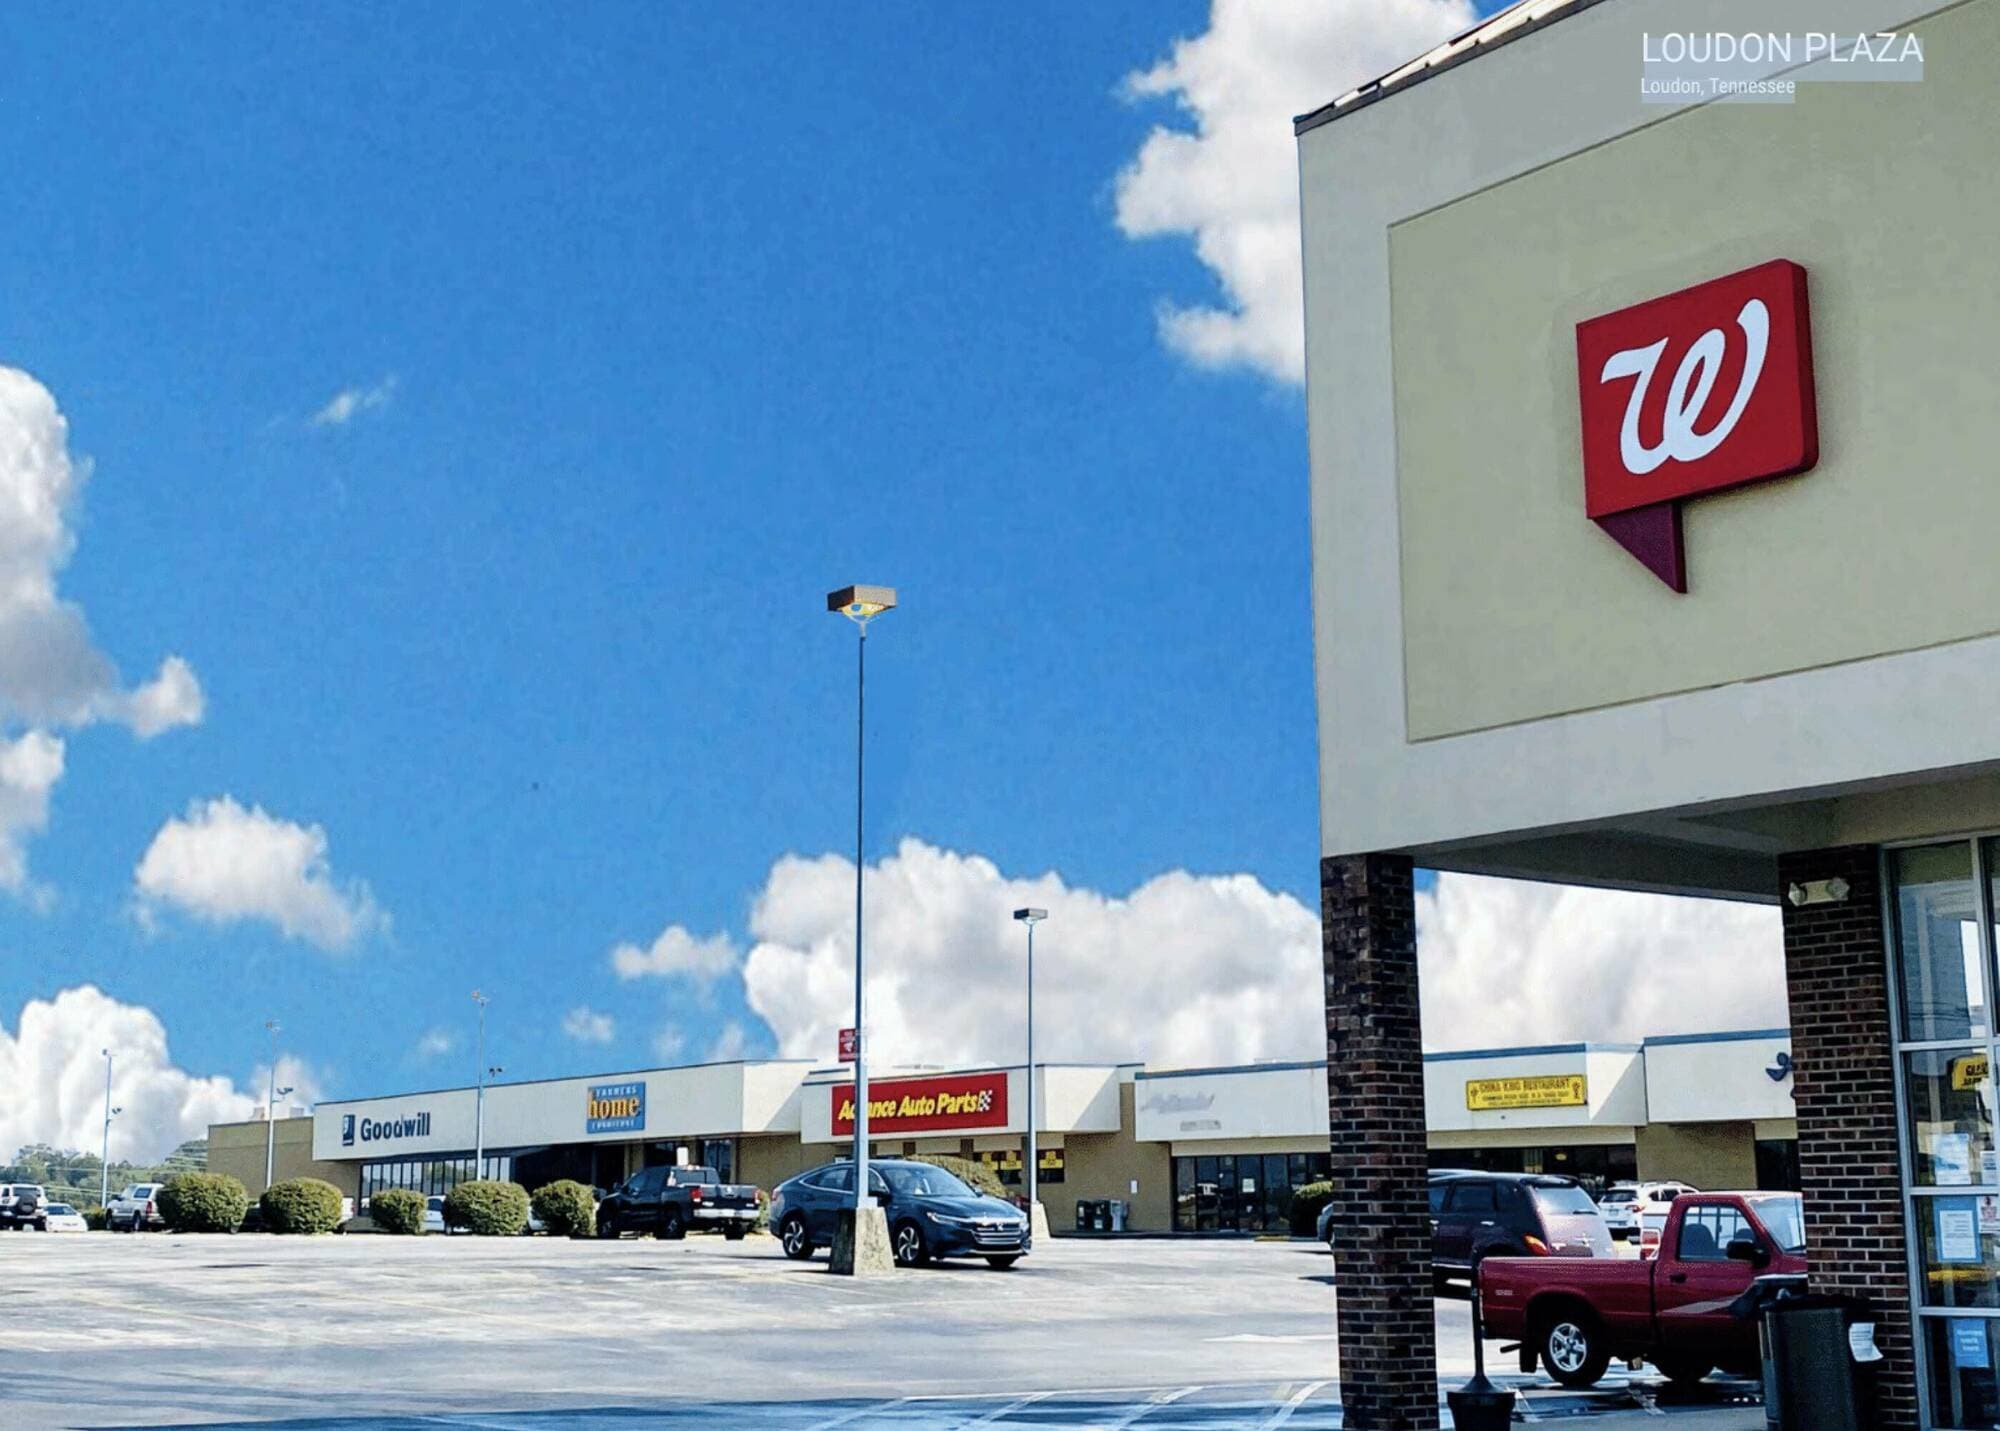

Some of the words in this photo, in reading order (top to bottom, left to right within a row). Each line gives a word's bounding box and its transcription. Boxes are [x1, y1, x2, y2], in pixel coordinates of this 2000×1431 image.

[588, 1091, 640, 1120] home
[897, 1095, 936, 1117] Auto
[936, 1092, 978, 1115] Parts
[360, 1112, 430, 1141] Goodwill
